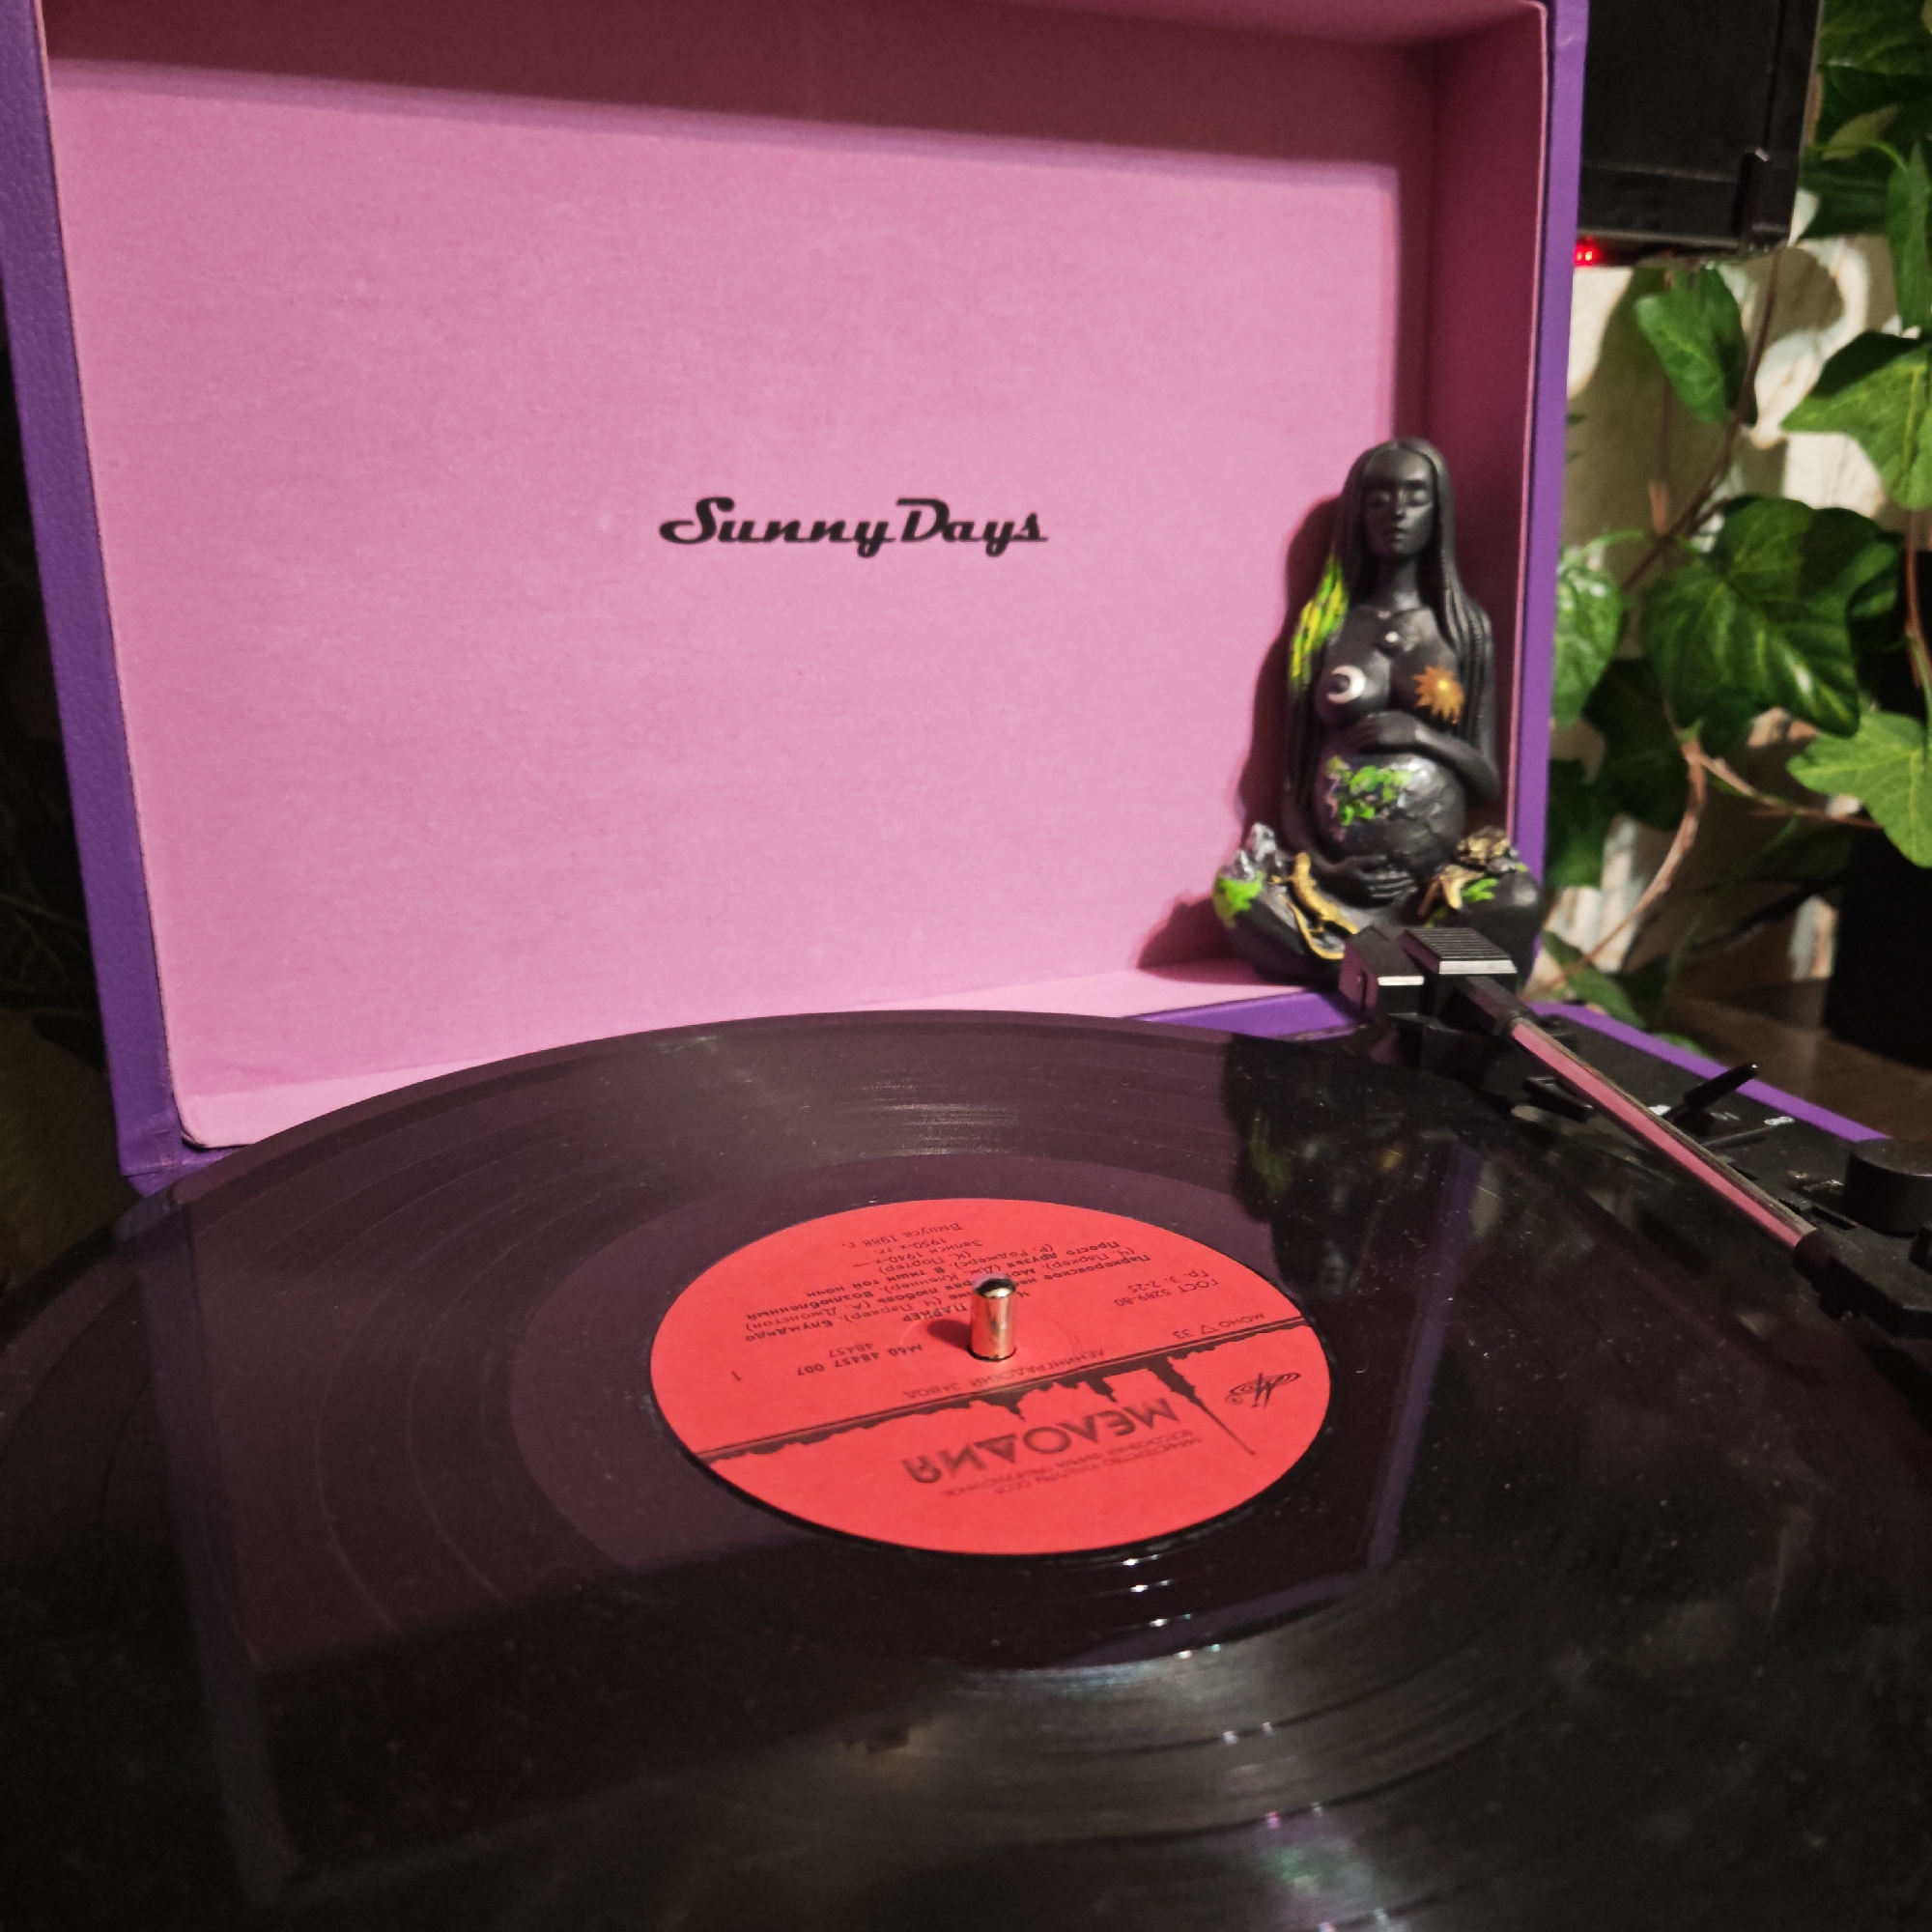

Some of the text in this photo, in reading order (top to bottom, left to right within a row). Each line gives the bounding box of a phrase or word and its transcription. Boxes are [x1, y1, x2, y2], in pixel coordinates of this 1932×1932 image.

[901, 1222, 964, 1238] Выпуск
[861, 1235, 898, 1247] 1988
[928, 1238, 983, 1255] Записи
[1065, 1240, 1121, 1256] Просто
[1113, 1278, 1220, 1308] ГОСТ 5289-80
[901, 1302, 968, 1322] ПАРКЕР
[1172, 1328, 1194, 1341] 33
[796, 1362, 825, 1377] 007
[903, 1399, 1179, 1485] МЕЛОДИЯ
